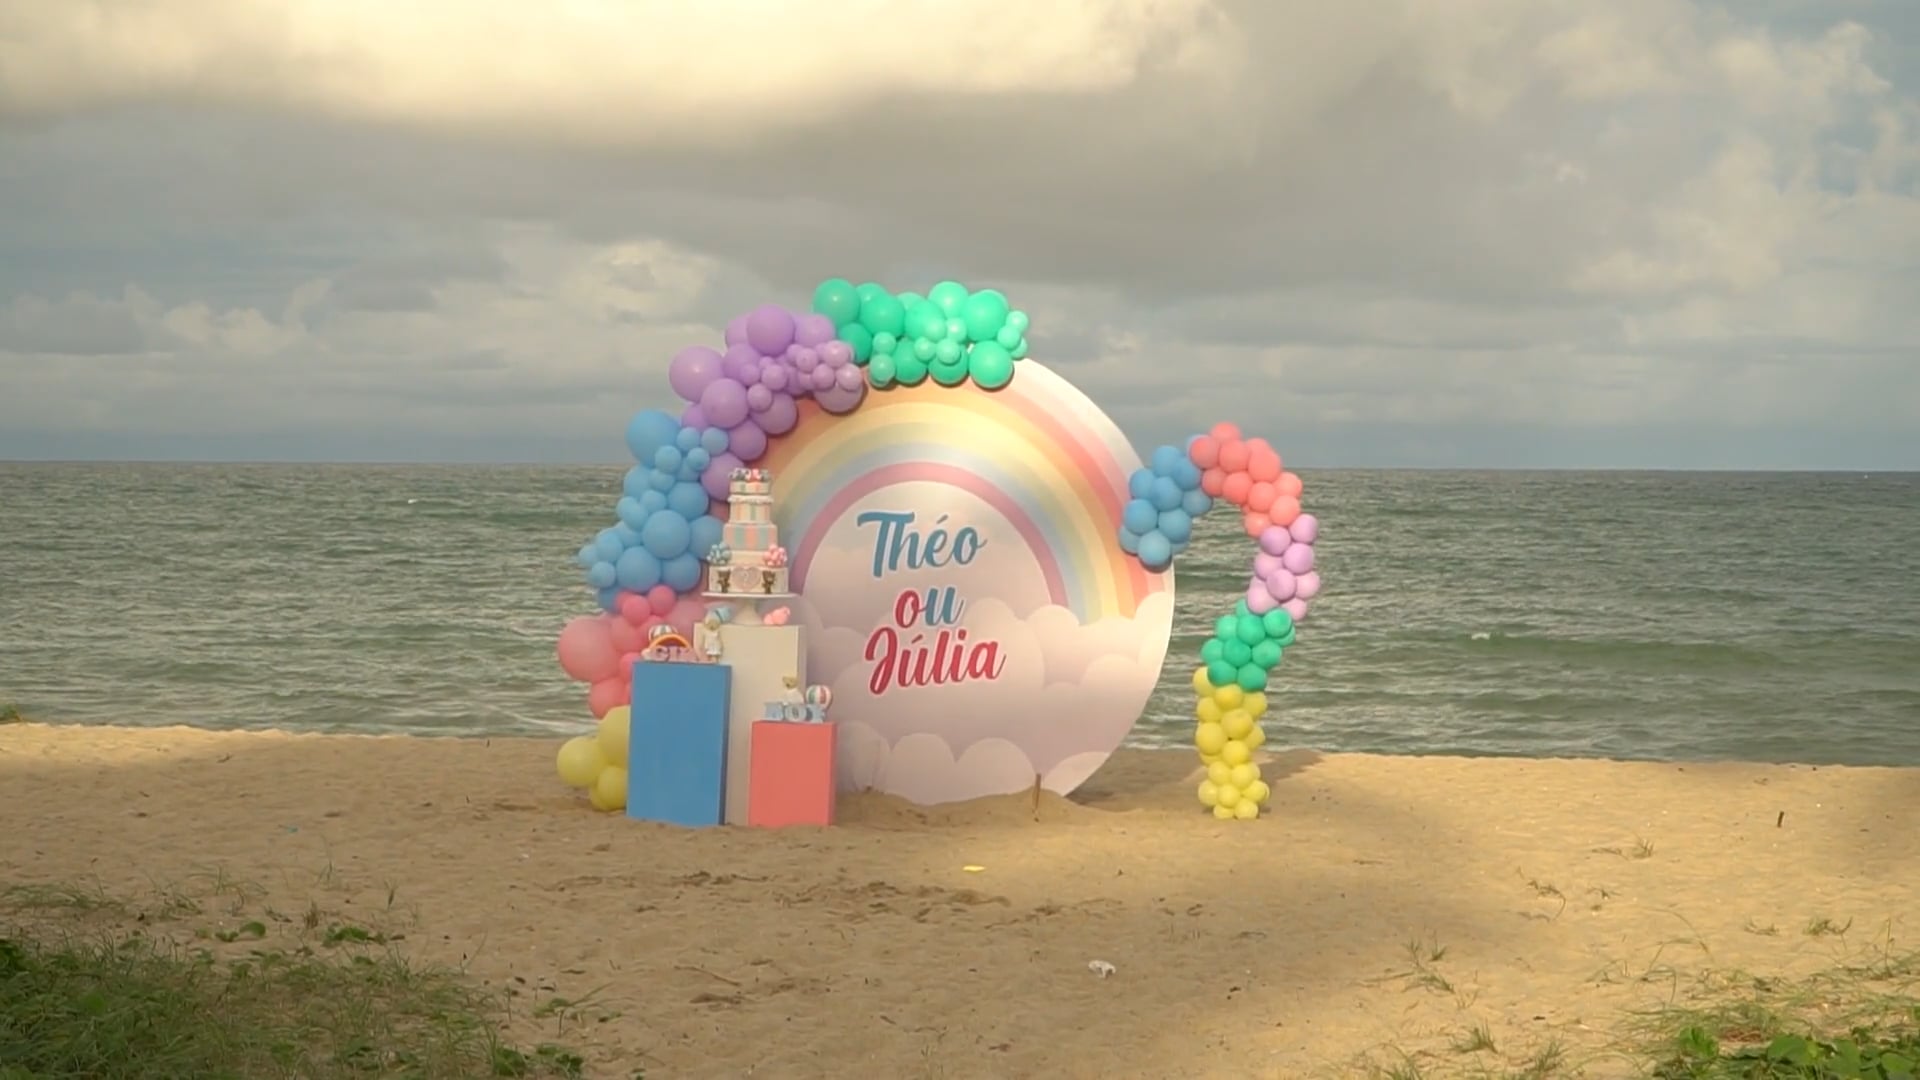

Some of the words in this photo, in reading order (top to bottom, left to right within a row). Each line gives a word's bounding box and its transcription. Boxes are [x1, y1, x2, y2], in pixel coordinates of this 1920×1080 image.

[857, 511, 988, 578] Théo
[895, 586, 964, 629] ou
[864, 626, 1006, 695] Júlia
